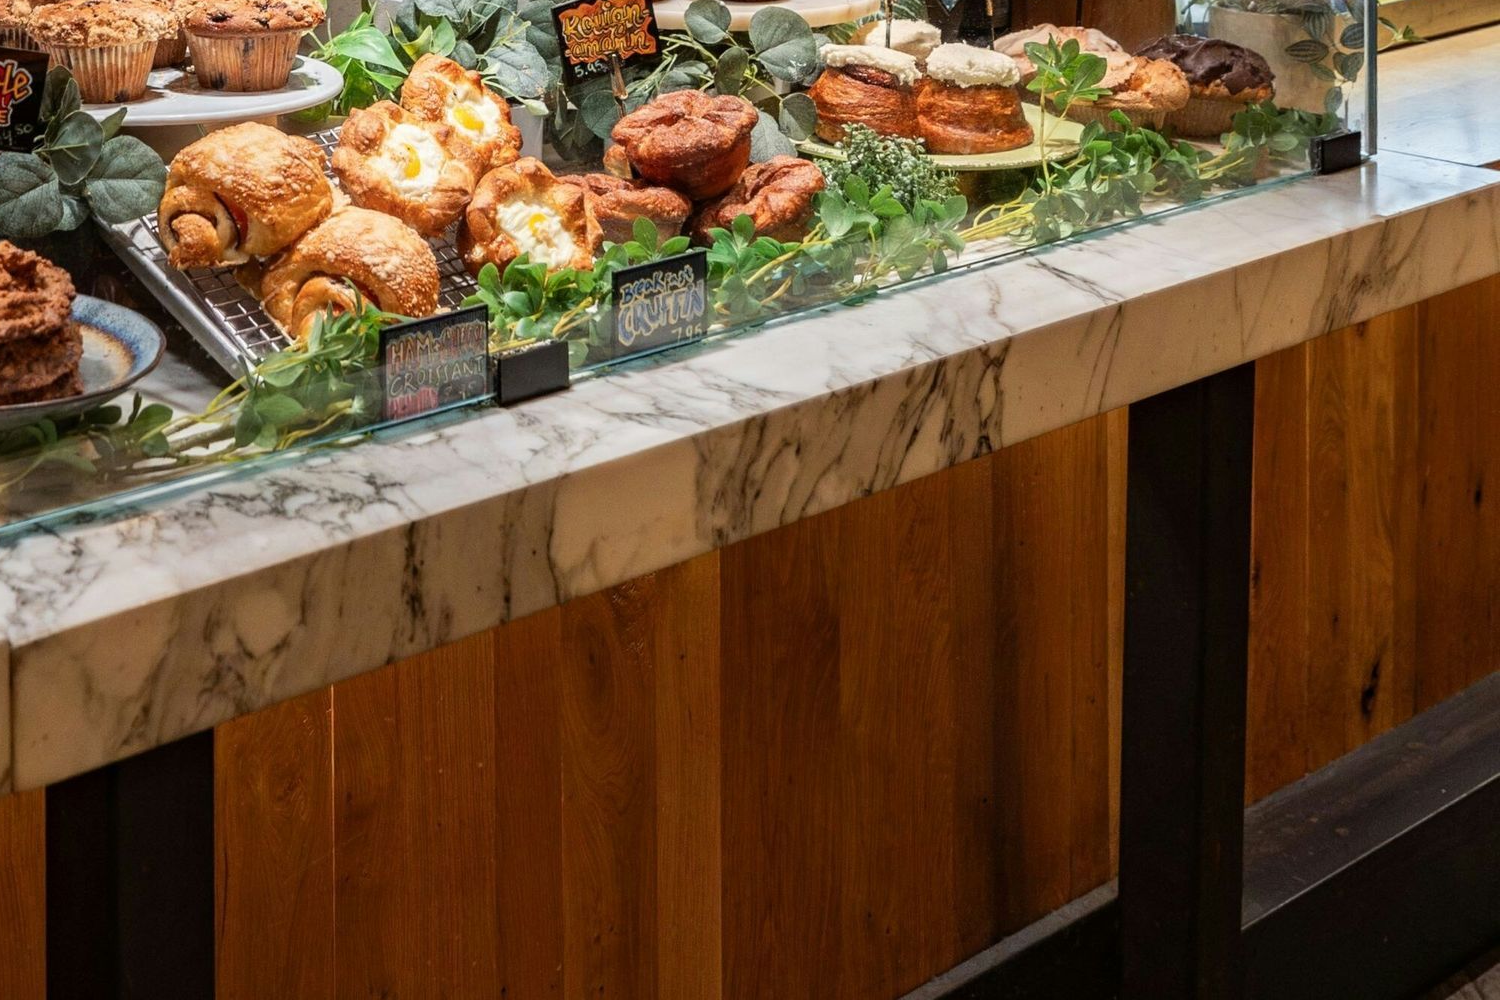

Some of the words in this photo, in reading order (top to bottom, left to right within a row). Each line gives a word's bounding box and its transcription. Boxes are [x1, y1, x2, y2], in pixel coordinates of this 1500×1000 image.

[620, 264, 694, 309] Breakfast
[618, 278, 705, 347] CRUFFIN
[389, 355, 484, 397] CROISSANT
[390, 331, 434, 376] HAM
